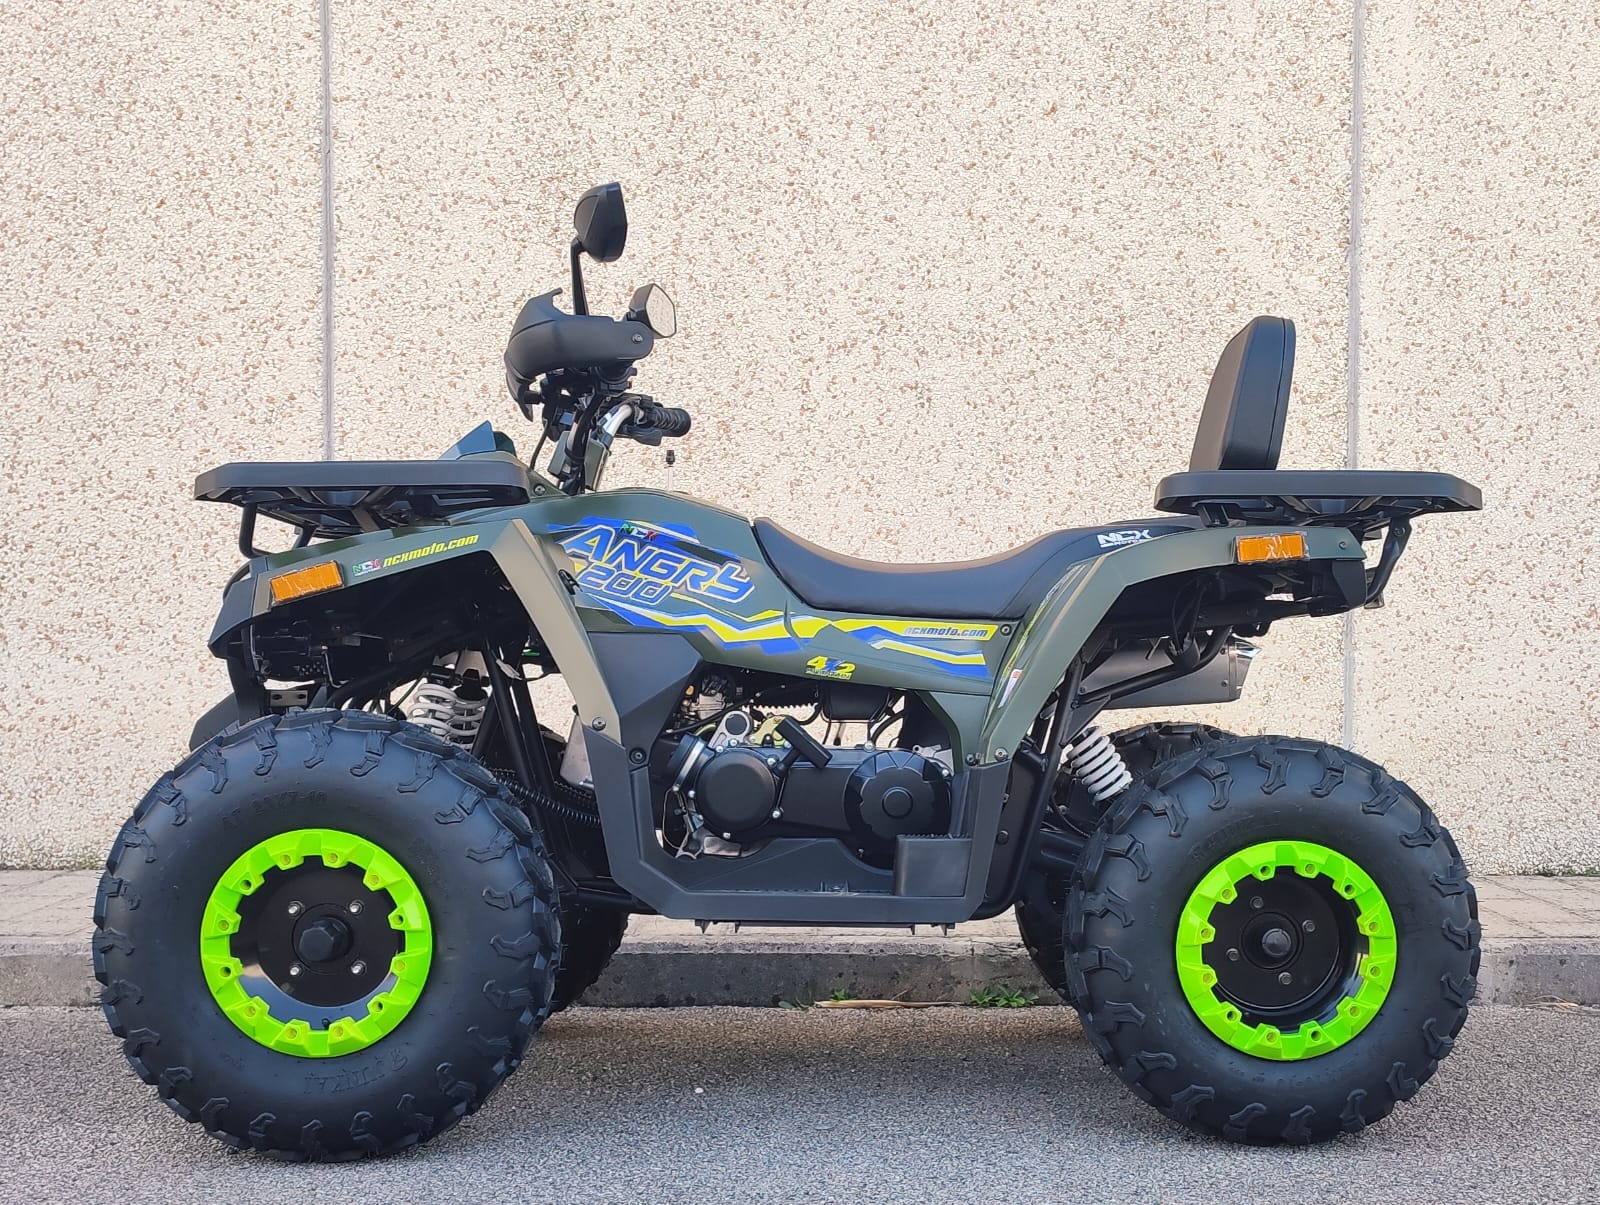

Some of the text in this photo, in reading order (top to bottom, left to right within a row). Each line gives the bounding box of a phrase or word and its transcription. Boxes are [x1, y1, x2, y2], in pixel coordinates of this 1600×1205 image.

[382, 534, 480, 568] ncxmoto.com
[560, 524, 755, 604] ANGRY
[576, 563, 674, 606] 200
